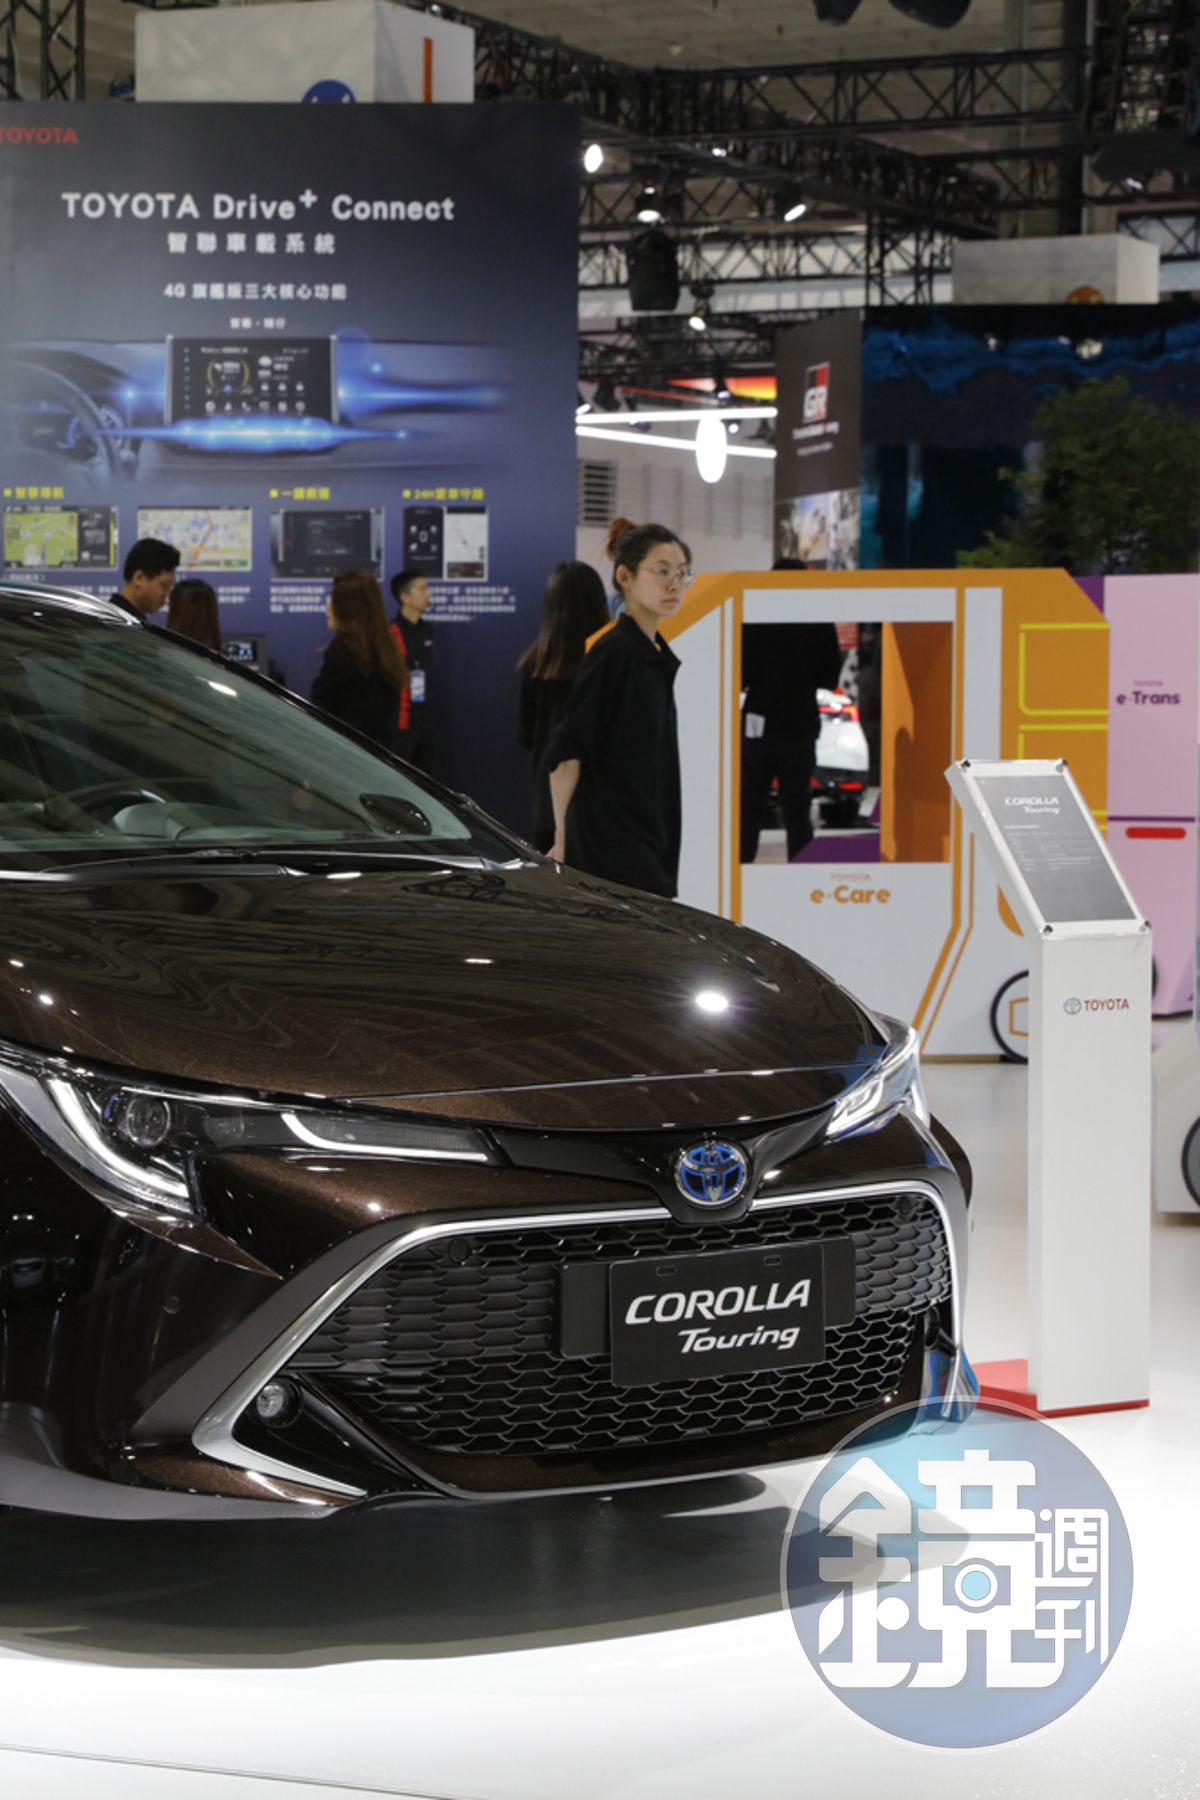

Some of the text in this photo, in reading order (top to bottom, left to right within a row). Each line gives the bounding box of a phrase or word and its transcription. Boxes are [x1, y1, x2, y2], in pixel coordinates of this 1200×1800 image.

[61, 193, 200, 218] TOYOTA
[331, 195, 455, 221] Connect
[1005, 797, 1059, 806] COROLLA
[1084, 998, 1130, 1012] TOYOTA
[625, 1278, 811, 1325] COROLLA
[678, 1325, 800, 1354] Touring
